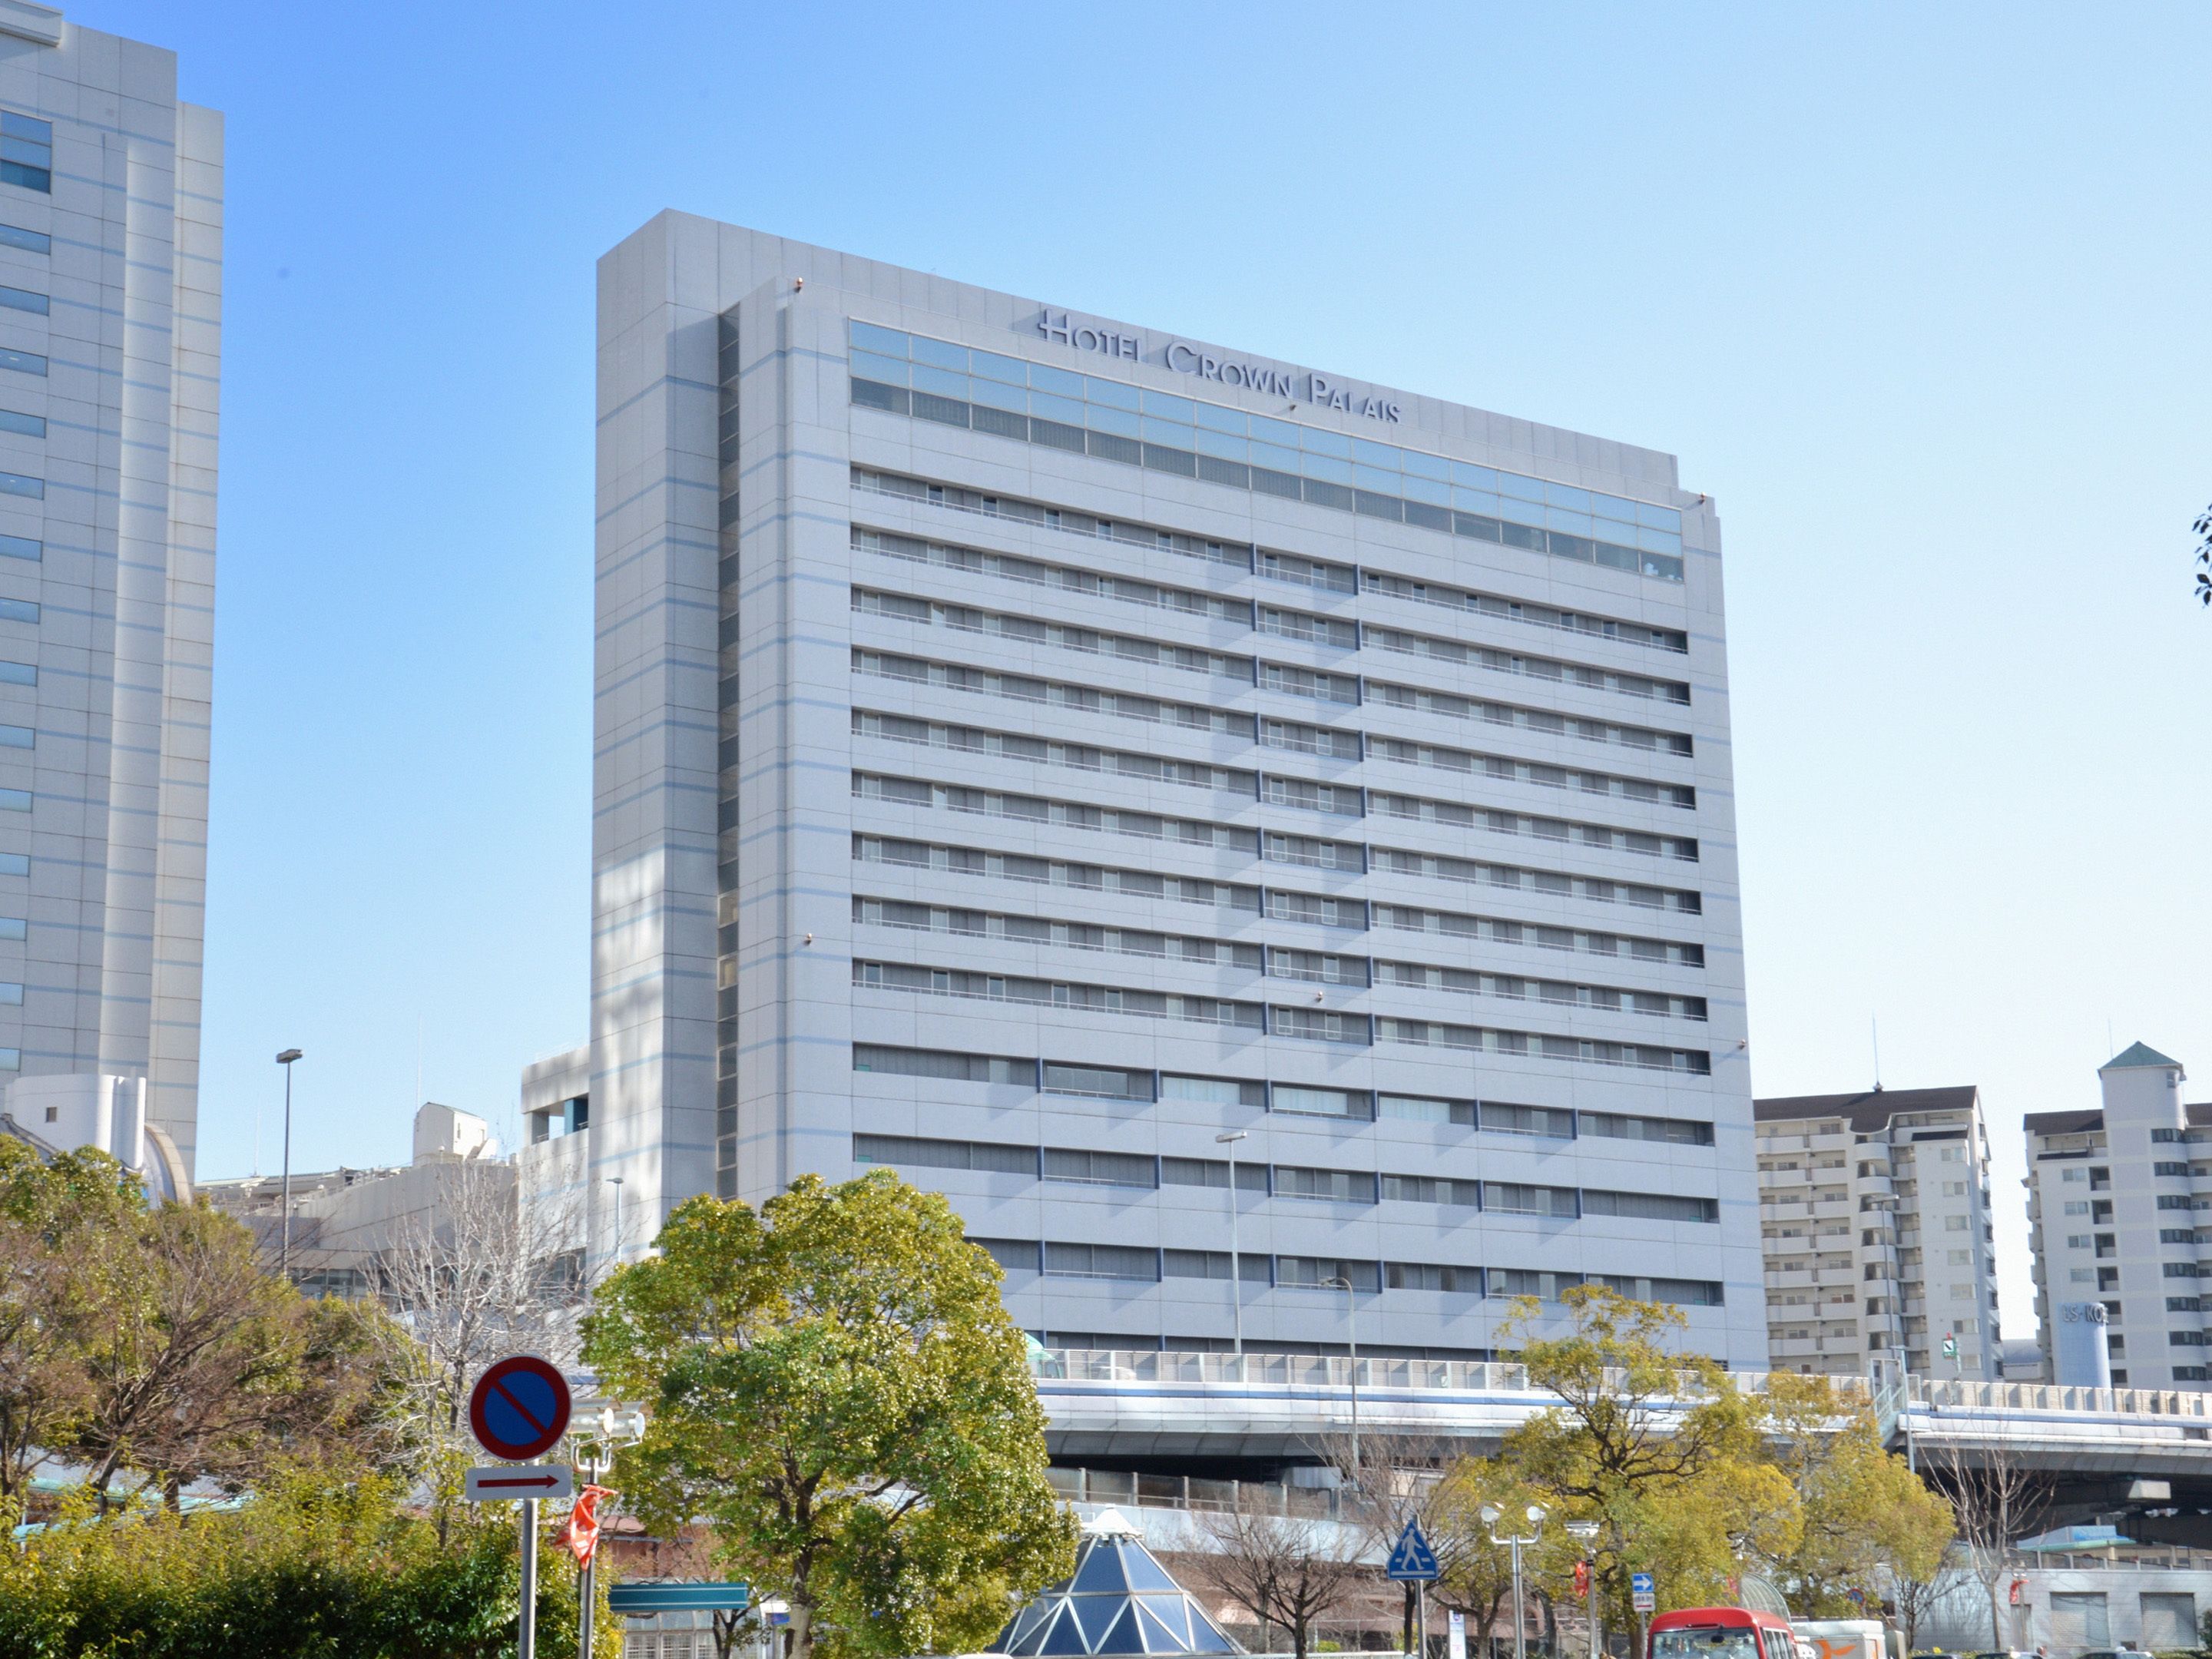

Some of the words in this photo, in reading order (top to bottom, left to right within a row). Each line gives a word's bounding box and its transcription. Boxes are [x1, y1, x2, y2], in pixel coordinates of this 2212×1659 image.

[1038, 309, 1144, 362] HOTEL
[1166, 340, 1294, 399] CROWN
[1309, 372, 1401, 424] PALAIS
